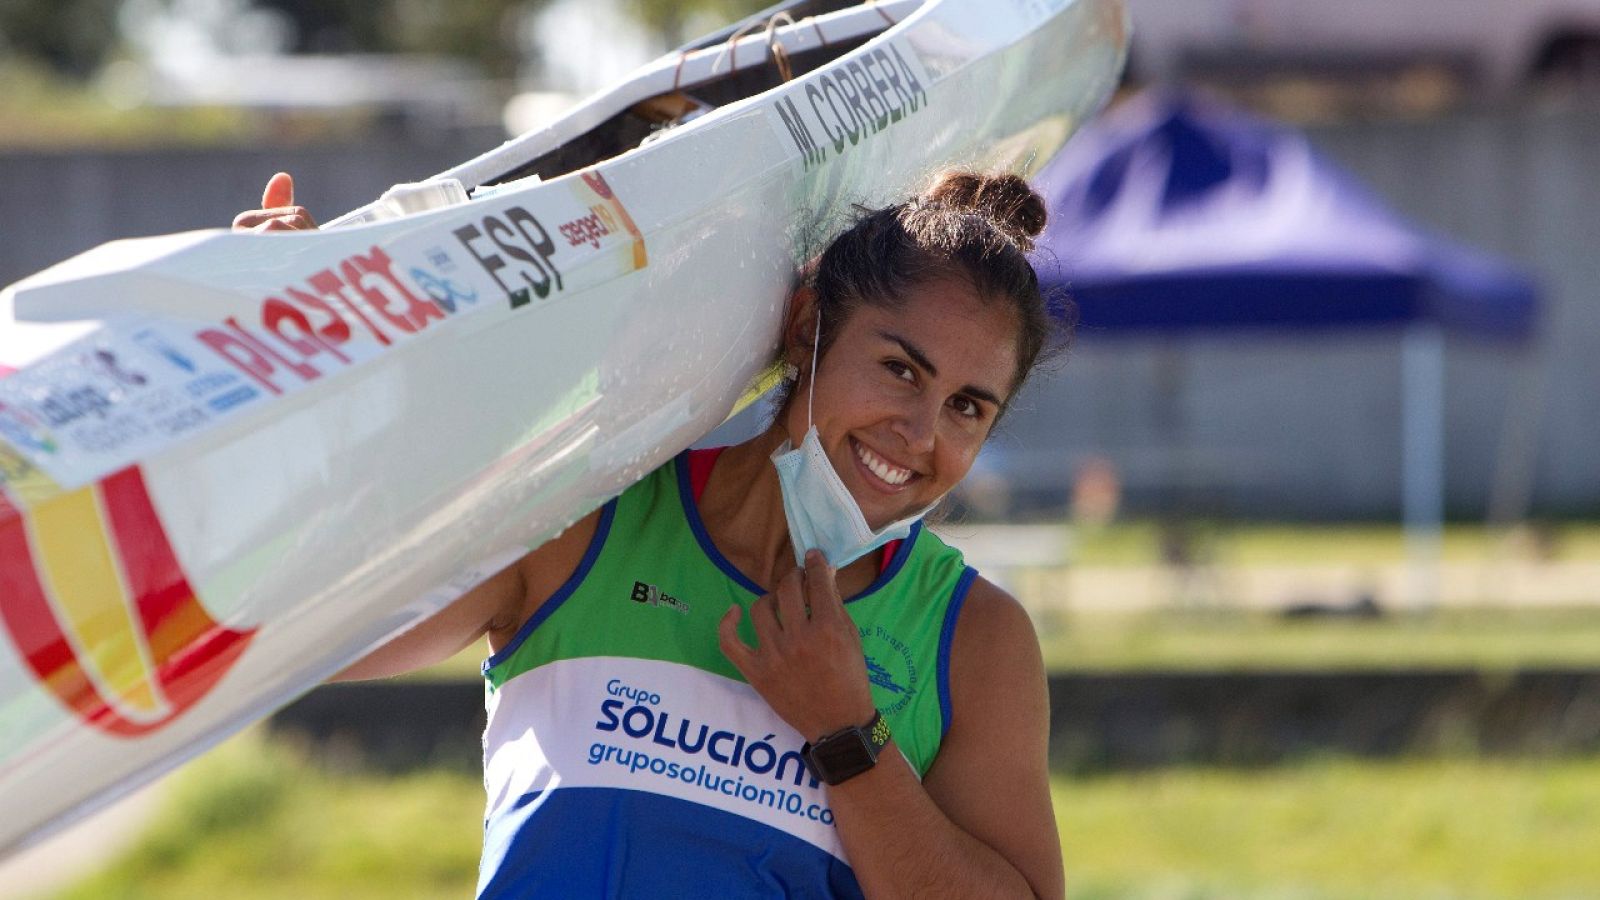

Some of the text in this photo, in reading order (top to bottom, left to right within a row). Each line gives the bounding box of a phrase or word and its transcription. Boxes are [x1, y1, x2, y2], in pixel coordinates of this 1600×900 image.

[774, 42, 928, 173] M. CORBERA
[453, 206, 563, 310] ESP
[607, 679, 661, 706] Grupo
[880, 687, 917, 716] Aranjue
[588, 742, 837, 827] gruposolucion10.co
[595, 699, 821, 790] SOLUCIÓN
